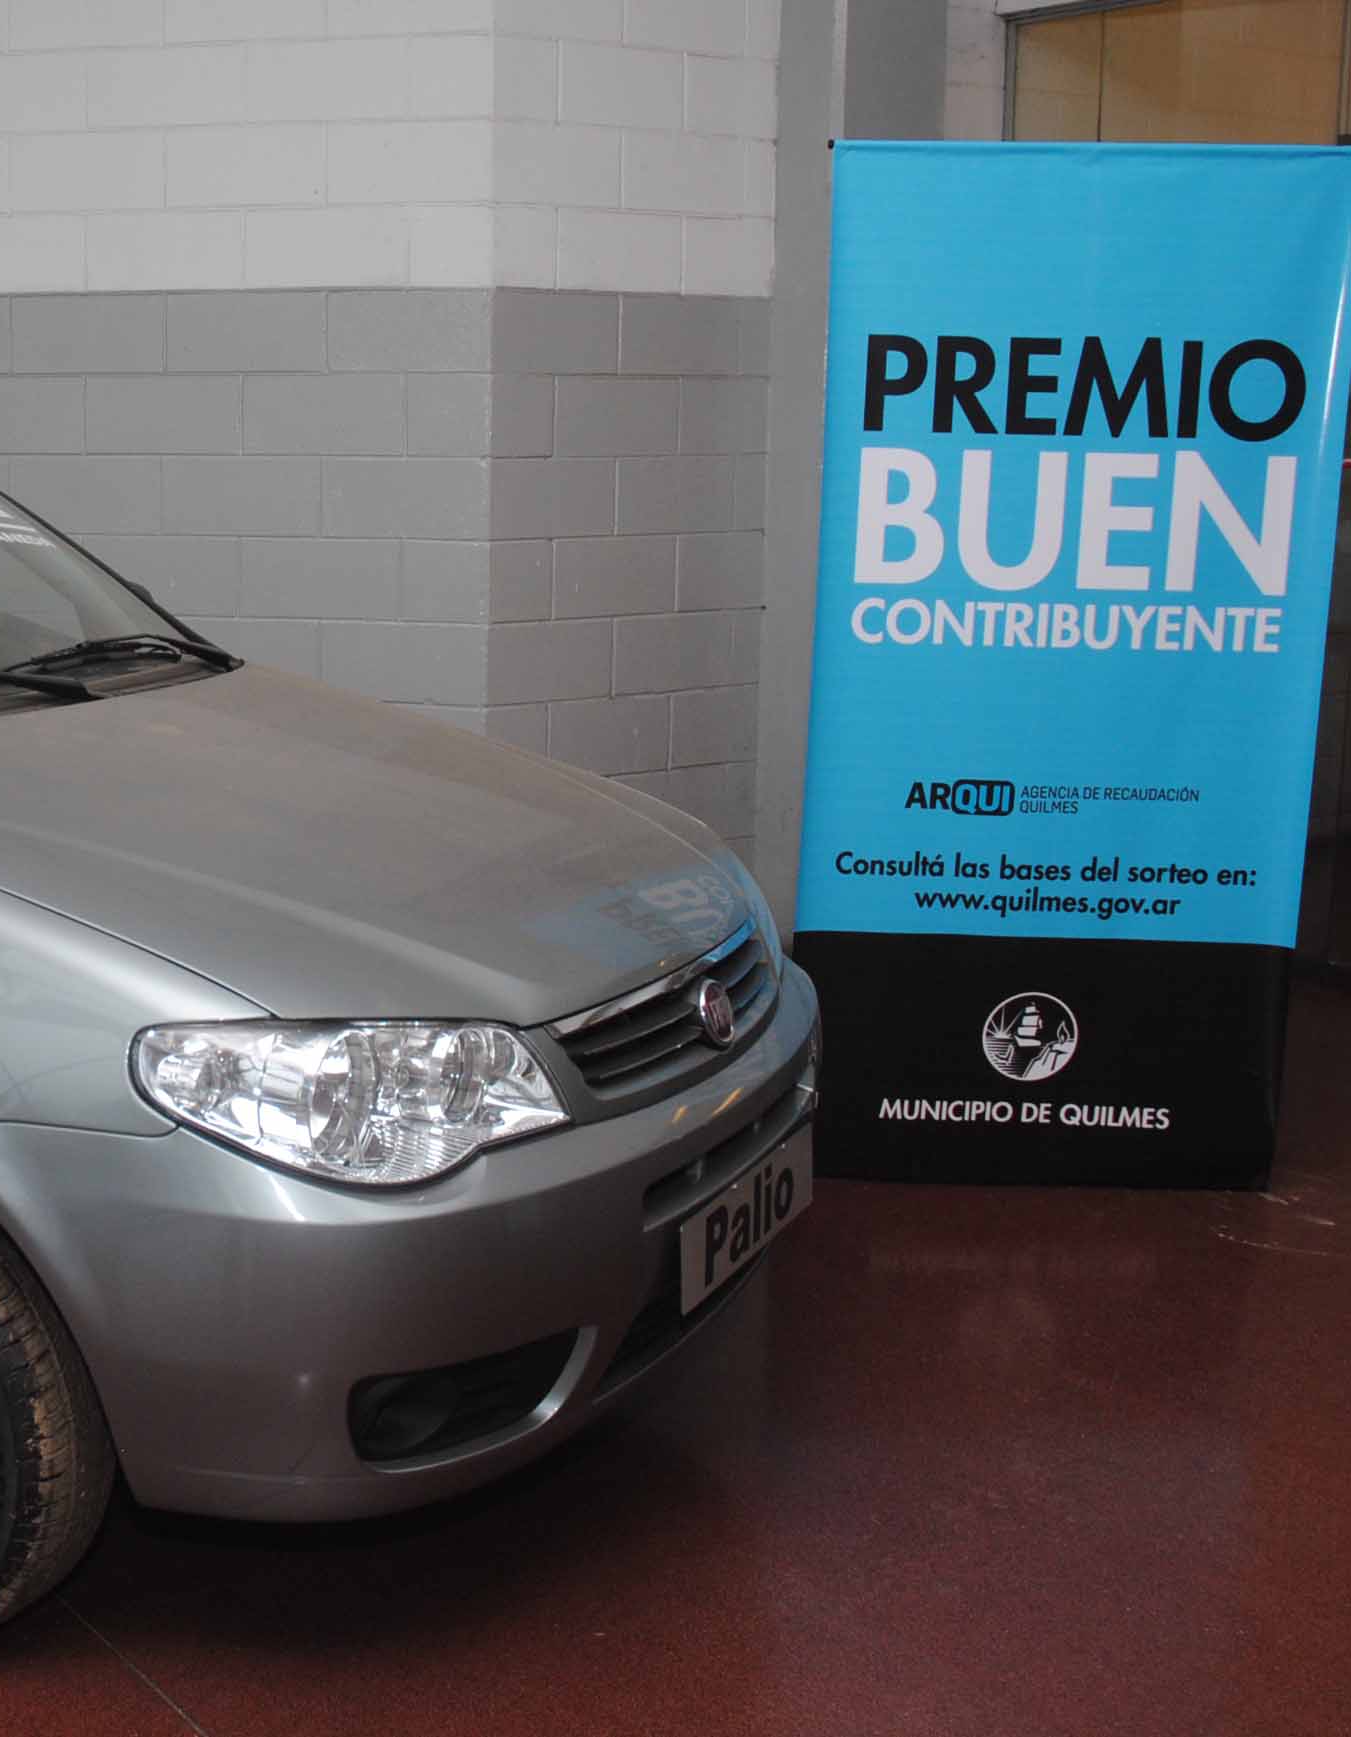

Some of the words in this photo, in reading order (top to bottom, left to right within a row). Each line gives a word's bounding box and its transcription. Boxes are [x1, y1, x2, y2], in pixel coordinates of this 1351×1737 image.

[863, 334, 1306, 442] PREMIO
[853, 447, 1298, 596] BUEN
[851, 597, 1283, 653] CONTRIBUYENTE
[905, 779, 1015, 816] ARQUI
[1019, 785, 1080, 800] AGENCIA
[1082, 786, 1101, 800] DE
[1103, 786, 1200, 802] RECAUDACIÓN
[1019, 800, 1078, 815] QUILMES
[835, 850, 945, 877] Consultá
[954, 852, 990, 879] las
[1000, 854, 1071, 882] bases
[1080, 856, 1120, 883] del
[1127, 860, 1208, 885] sorteo
[1216, 867, 1257, 887] en:
[914, 886, 1182, 920] www.quilmes.gov.ar
[878, 1098, 1013, 1122] MUNICIPIO
[1021, 1102, 1052, 1123] DE
[1059, 1103, 1170, 1130] QUILMES
[705, 1162, 795, 1286] Palio
